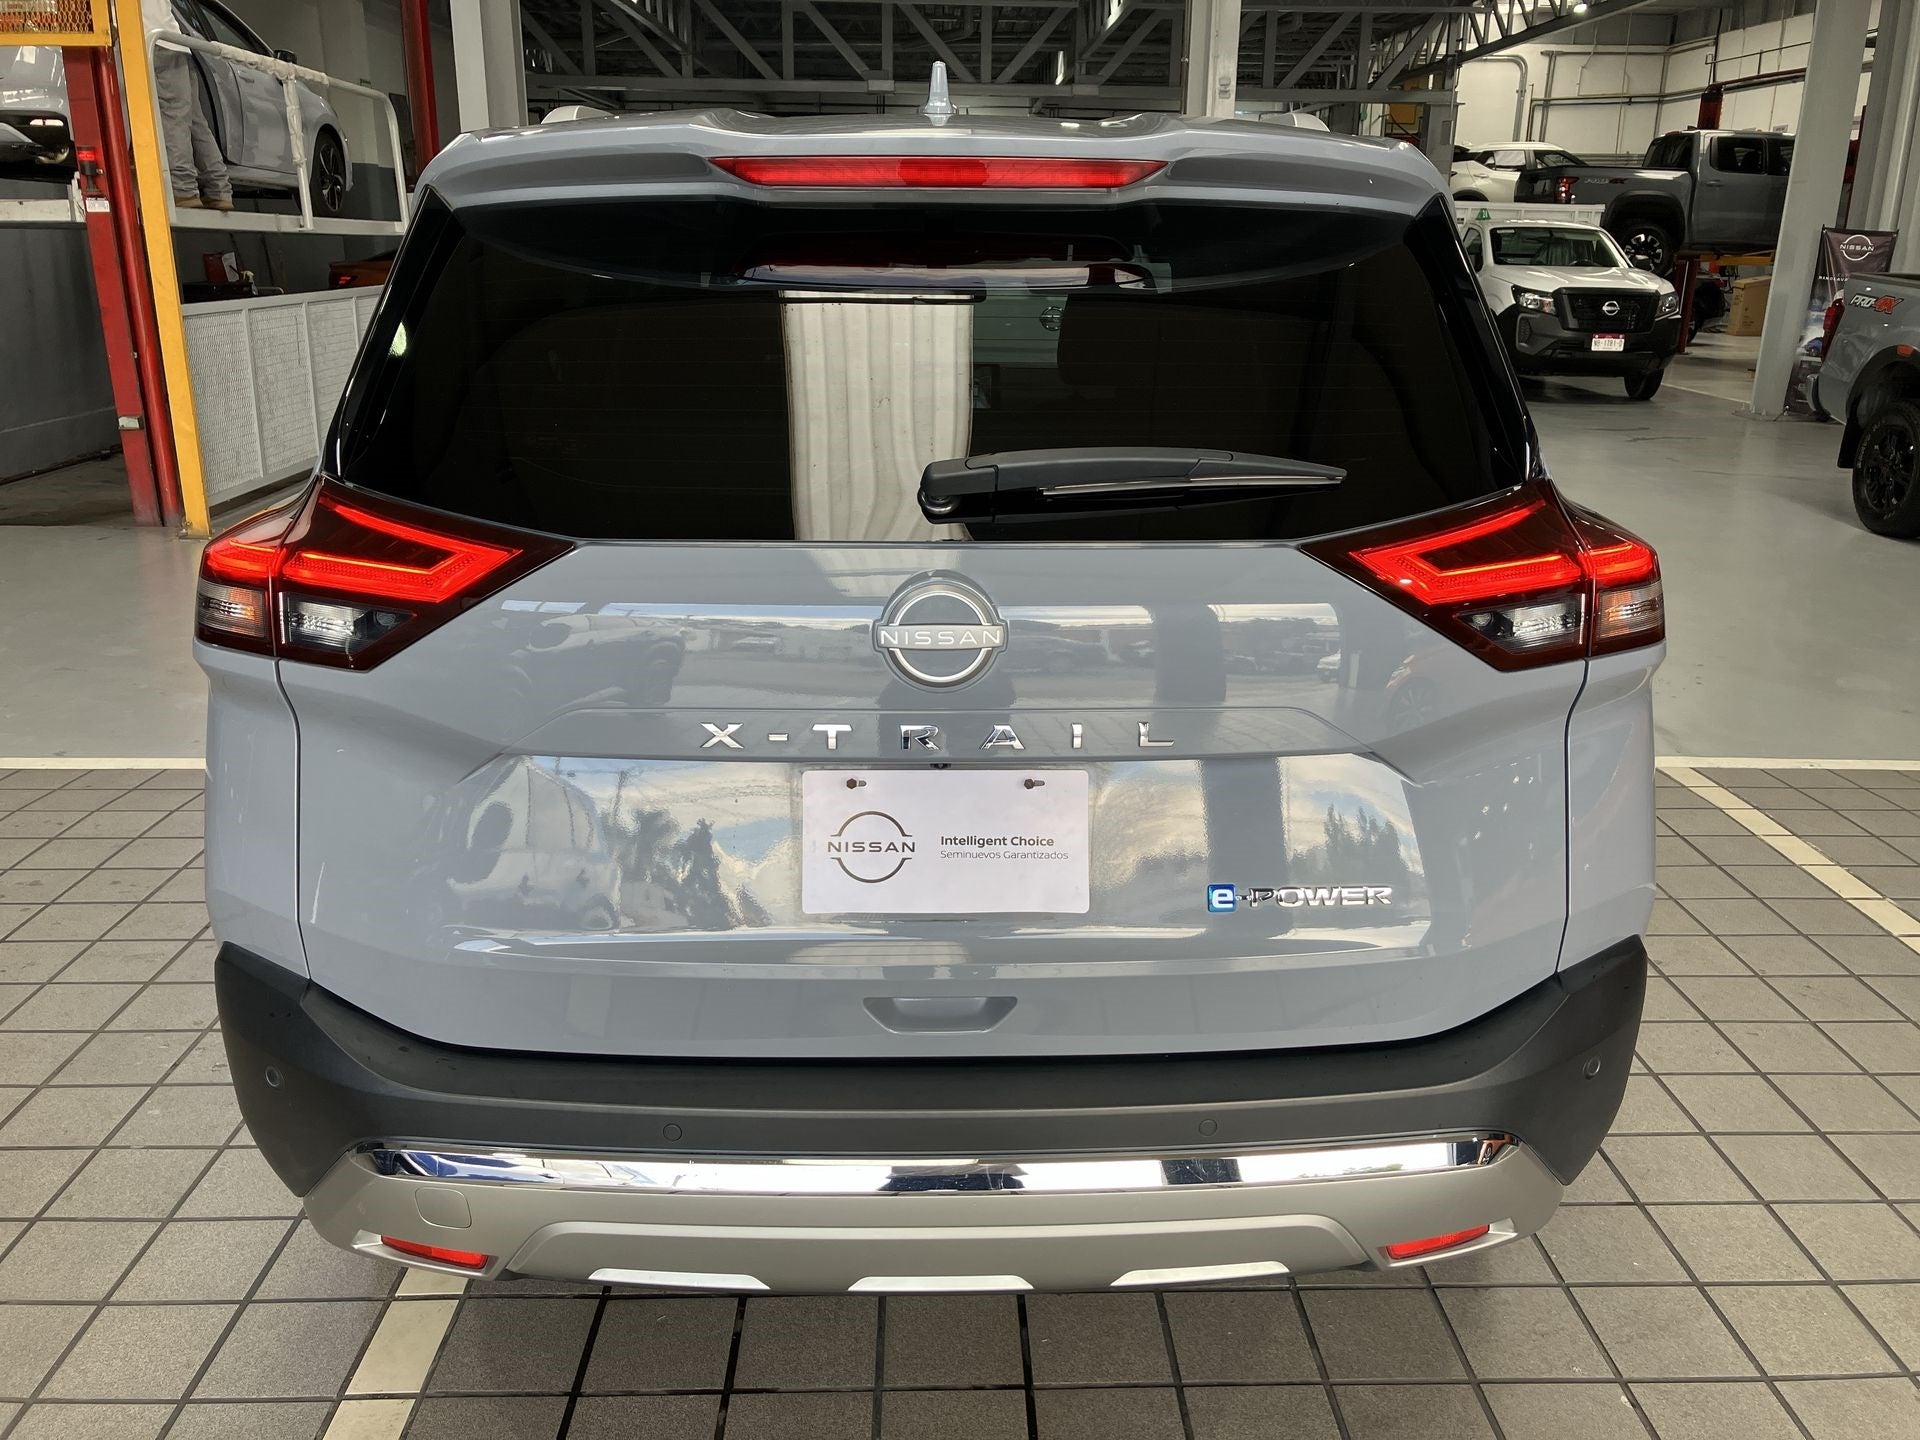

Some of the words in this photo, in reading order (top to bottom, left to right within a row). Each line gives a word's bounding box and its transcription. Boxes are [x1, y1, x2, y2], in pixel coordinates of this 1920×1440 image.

[1839, 243, 1875, 253] NISSAN
[1850, 293, 1904, 314] PRO-4X
[880, 629, 1001, 645] NISSAN
[699, 721, 1175, 751] X-TRAIL
[827, 840, 916, 853] NISSAN
[940, 835, 1008, 849] Intelligent
[1010, 836, 1055, 847] Choice
[940, 850, 1001, 860] Seminuevos
[1003, 850, 1069, 860] Garantizados
[1208, 884, 1394, 911] e-POWER
